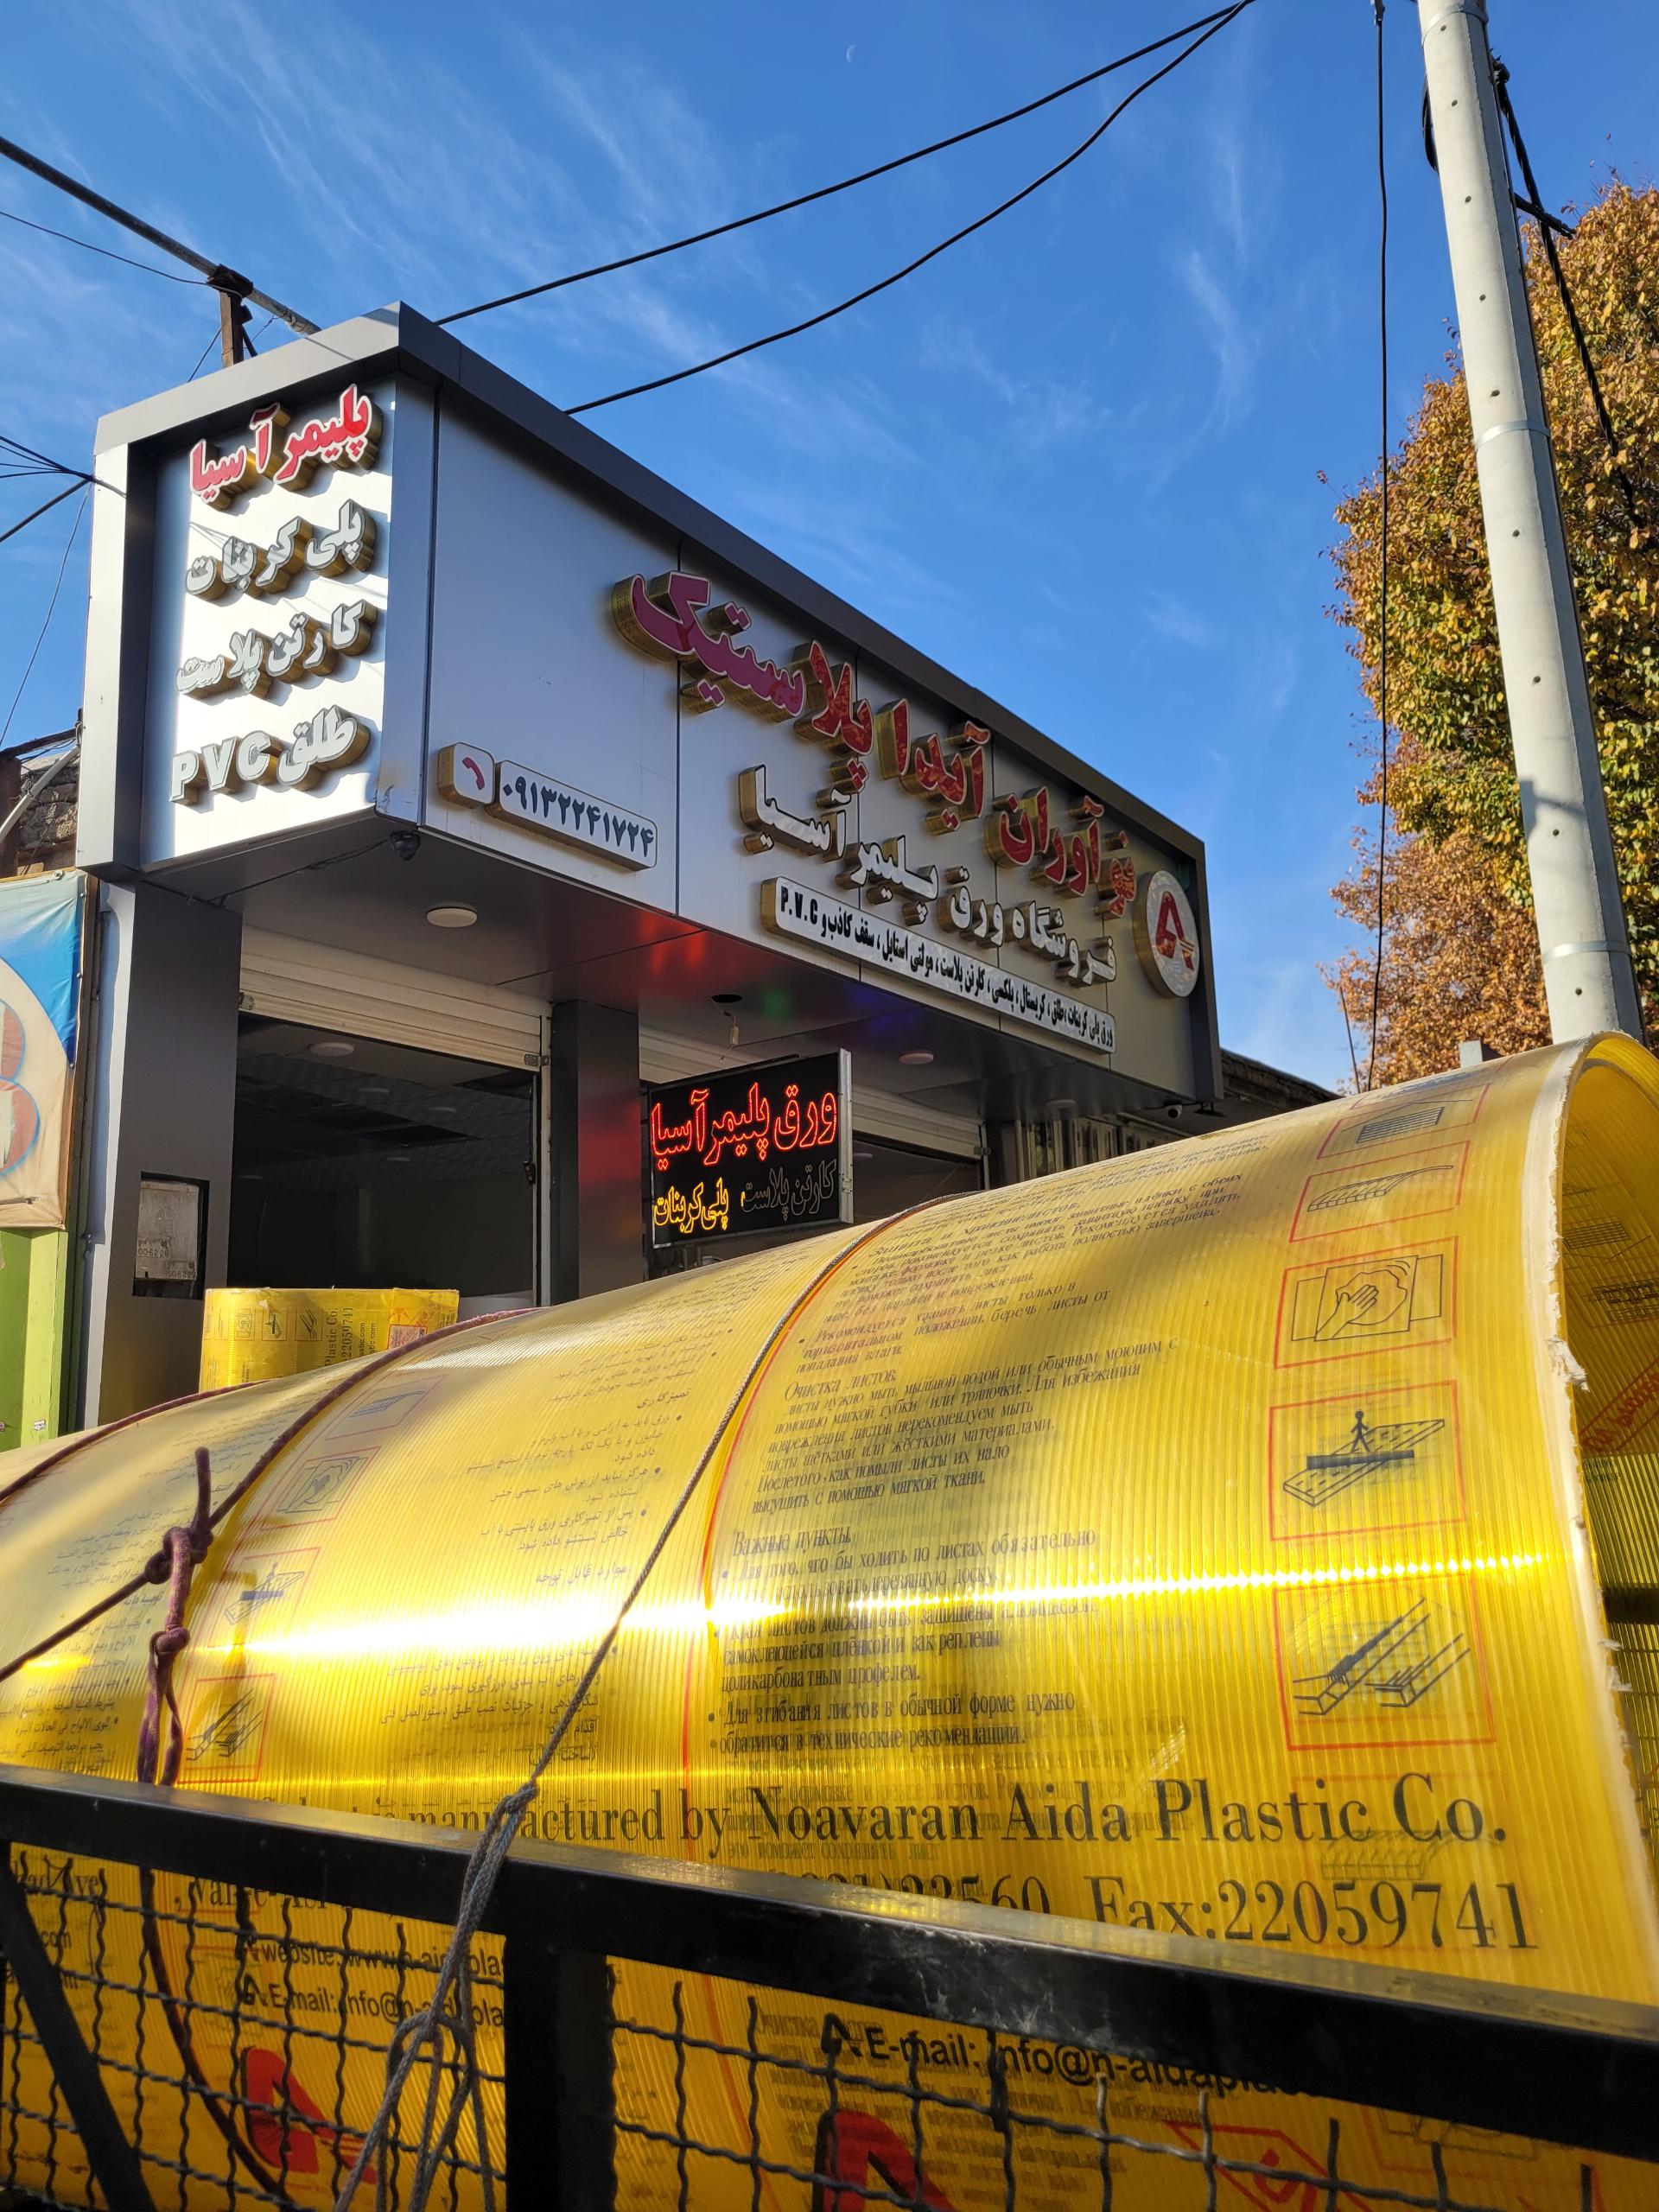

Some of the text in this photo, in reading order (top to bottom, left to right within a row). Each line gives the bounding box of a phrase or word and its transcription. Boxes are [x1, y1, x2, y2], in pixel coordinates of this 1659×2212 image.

[189, 383, 372, 499] پلیمر آسیا
[306, 499, 368, 567] پلی
[175, 626, 264, 695] پلاست
[629, 569, 874, 793] پلاستیک
[168, 703, 359, 805] طلق PVC
[889, 696, 990, 834] آیدا
[754, 764, 1117, 987] فروشگاه ورق پلیمر آسیا
[651, 1081, 837, 1172] ورق پلیمر آسیا
[652, 1176, 730, 1235] پلی کربنات
[791, 1159, 837, 1217] کارتن
[325, 1306, 338, 1325] Co.
[784, 1379, 842, 1402] Очистка
[824, 1392, 865, 1413] нужно
[961, 1365, 1001, 1386] водой
[1006, 1362, 1033, 1377] или
[1037, 1353, 1099, 1372] обычным
[831, 1405, 875, 1425] мягкой
[930, 1393, 955, 1410] или
[1061, 1362, 1141, 1389] избежания
[849, 1422, 893, 1441] листов
[860, 1443, 886, 1459] или
[752, 1491, 810, 1516] высушить
[890, 1473, 938, 1496] мягкой
[855, 1459, 903, 1481] помыли
[907, 1452, 948, 1472] листы
[733, 1529, 791, 1557] Важные
[833, 1550, 854, 1571] бы
[935, 1540, 985, 1561] листах
[899, 1691, 963, 1716] обычной
[969, 1691, 1016, 1719] форме
[1026, 1691, 1076, 1716] нужно
[662, 1789, 730, 1859] by
[750, 1783, 978, 1842] Noavaran
[1006, 1778, 1133, 1842] Aida
[1147, 1776, 1374, 1842] Plastic
[1392, 1771, 1508, 1842] Co.
